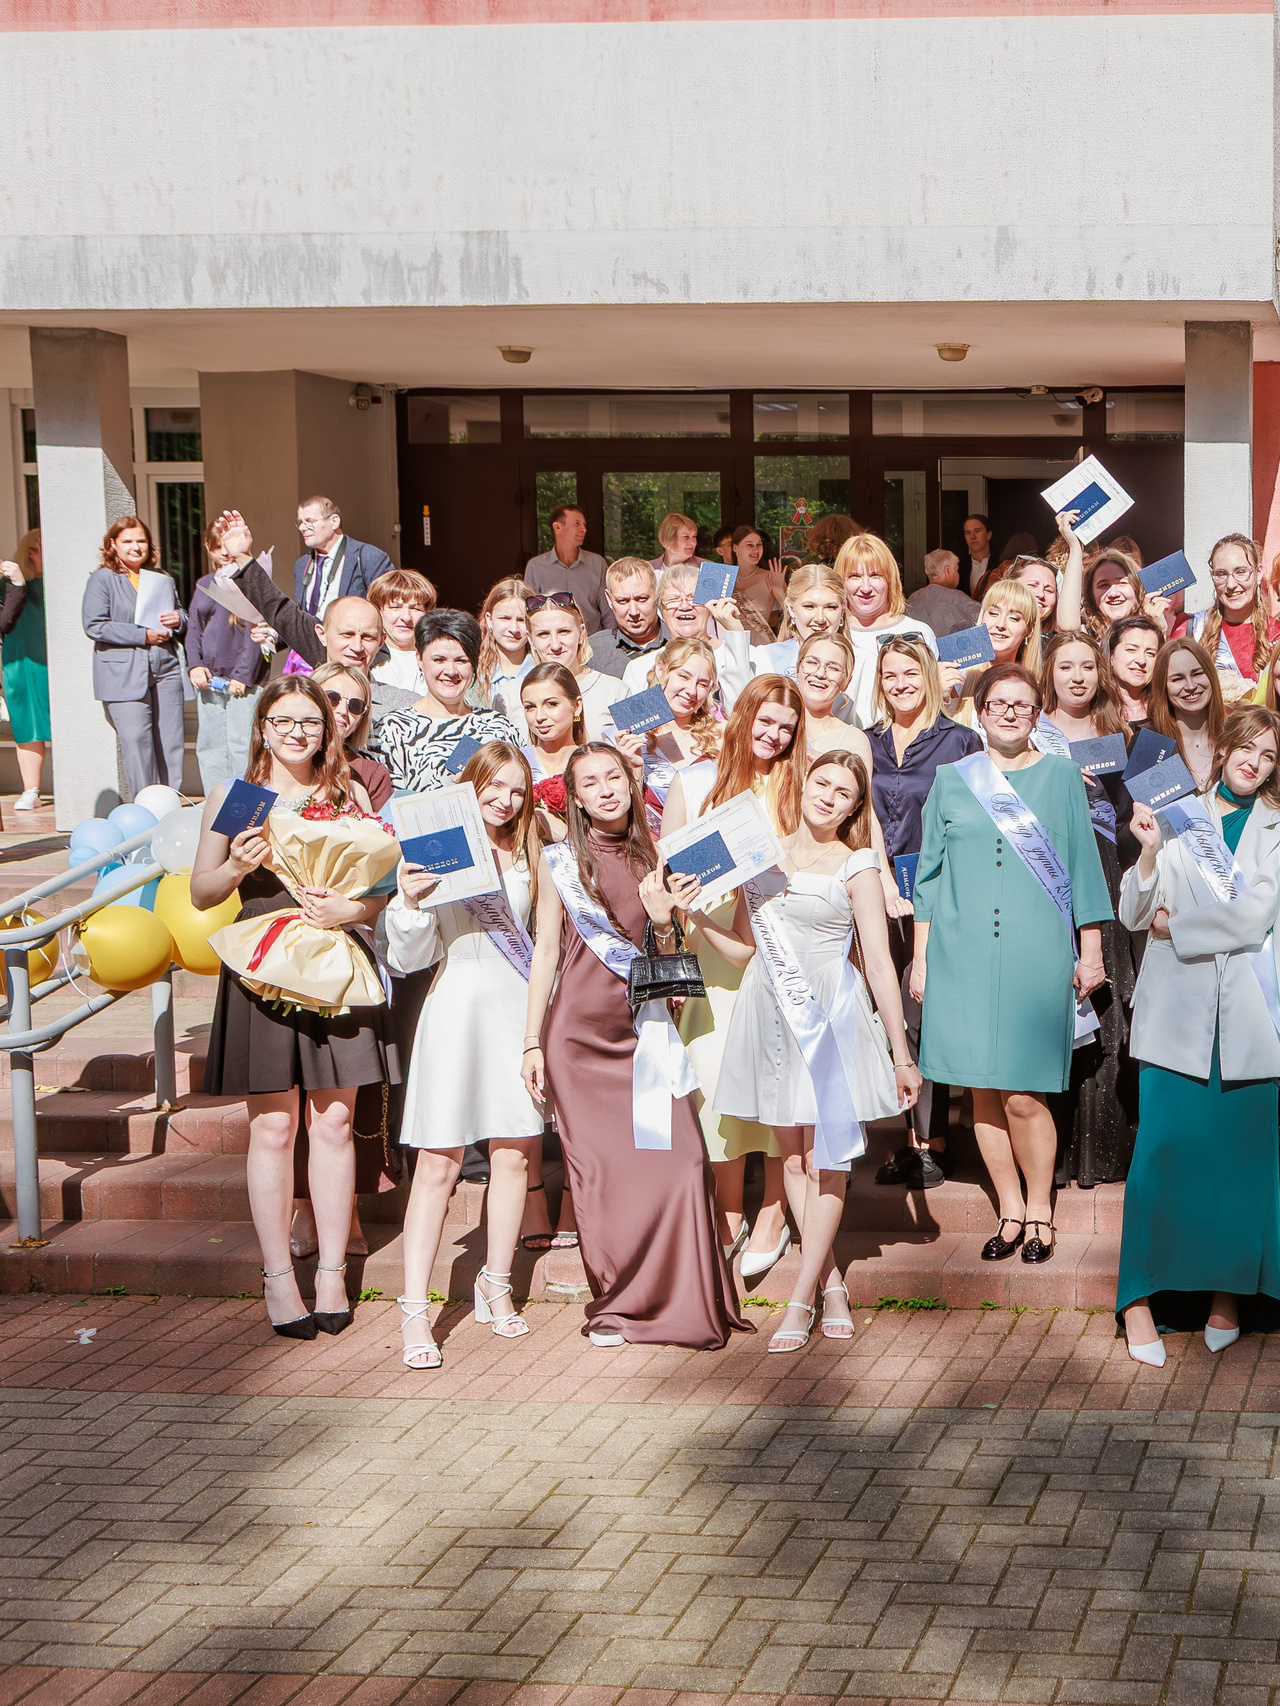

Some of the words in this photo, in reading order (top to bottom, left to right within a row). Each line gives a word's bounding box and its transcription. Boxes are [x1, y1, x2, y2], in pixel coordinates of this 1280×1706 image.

[630, 714, 660, 731] ДЫПЛОМ
[1085, 760, 1116, 771] ДЫПЛОМ
[1149, 783, 1182, 805] ДЫПЛОМ
[1021, 842, 1060, 880] группы
[473, 891, 526, 959] Выпускница
[745, 881, 787, 968] Выпускница
[776, 964, 816, 1006] 2025
